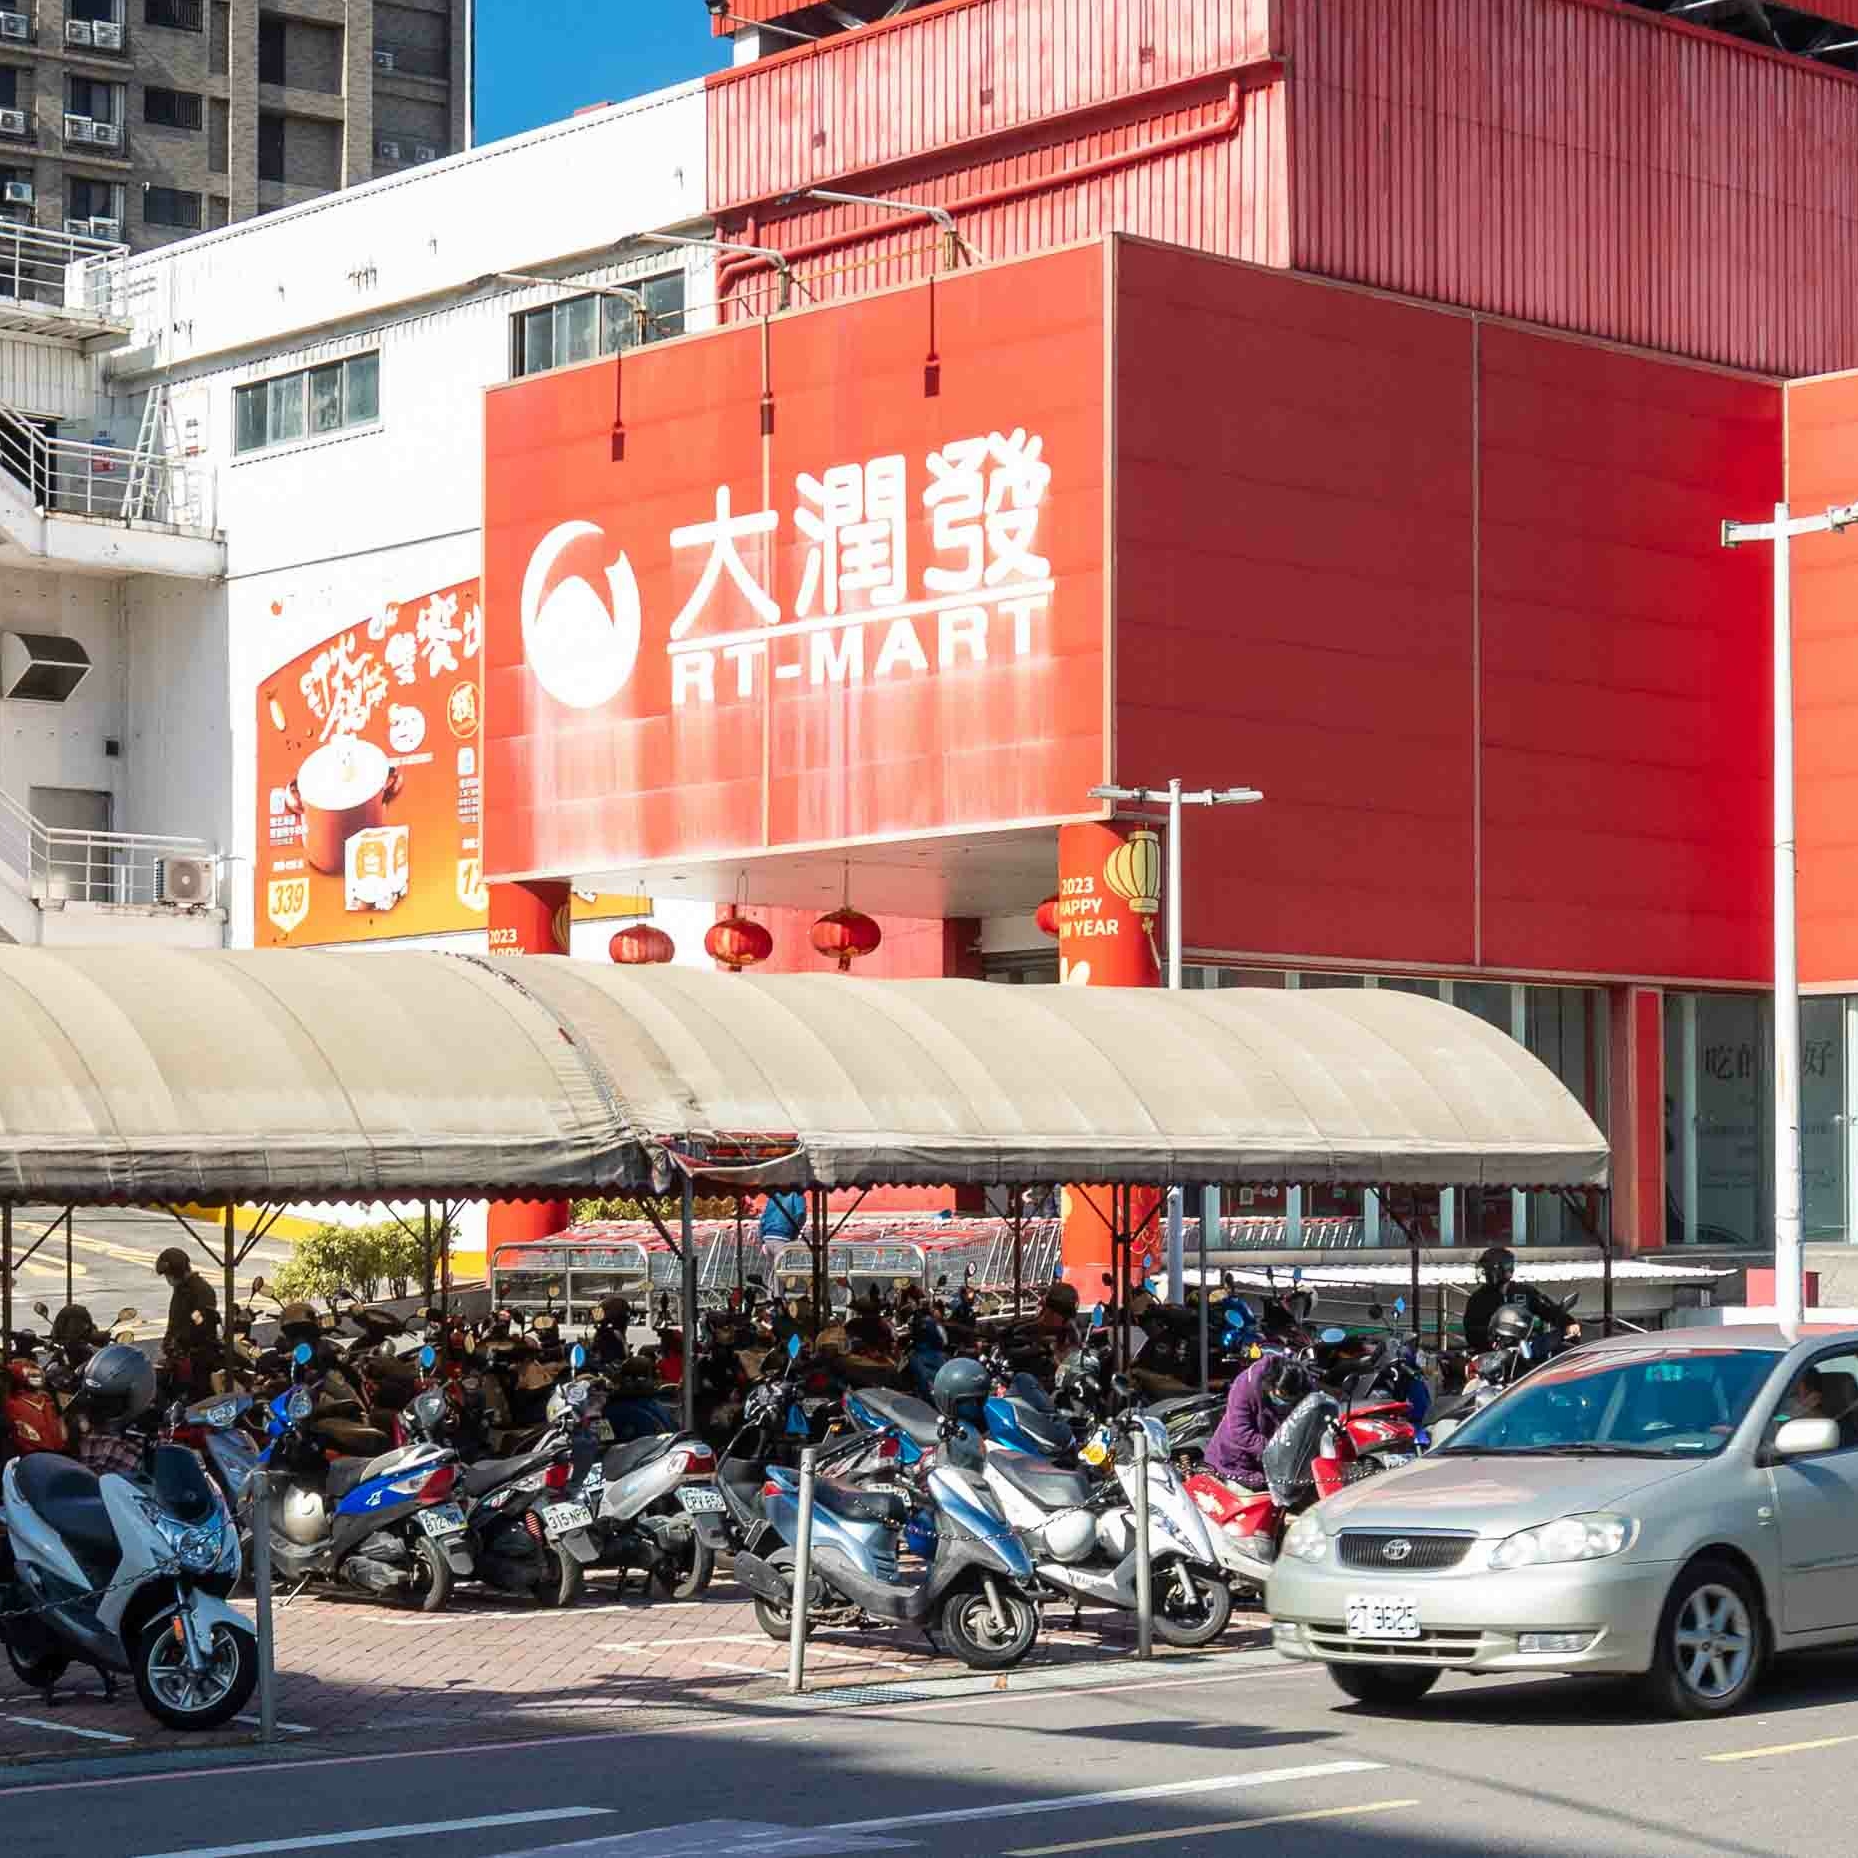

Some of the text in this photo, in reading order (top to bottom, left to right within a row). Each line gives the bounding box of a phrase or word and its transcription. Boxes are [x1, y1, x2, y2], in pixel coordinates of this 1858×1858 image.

[669, 427, 1053, 637] 大潤發
[671, 595, 1051, 708] RT-MART
[272, 883, 304, 916] 339
[1073, 918, 1119, 938] YEAR
